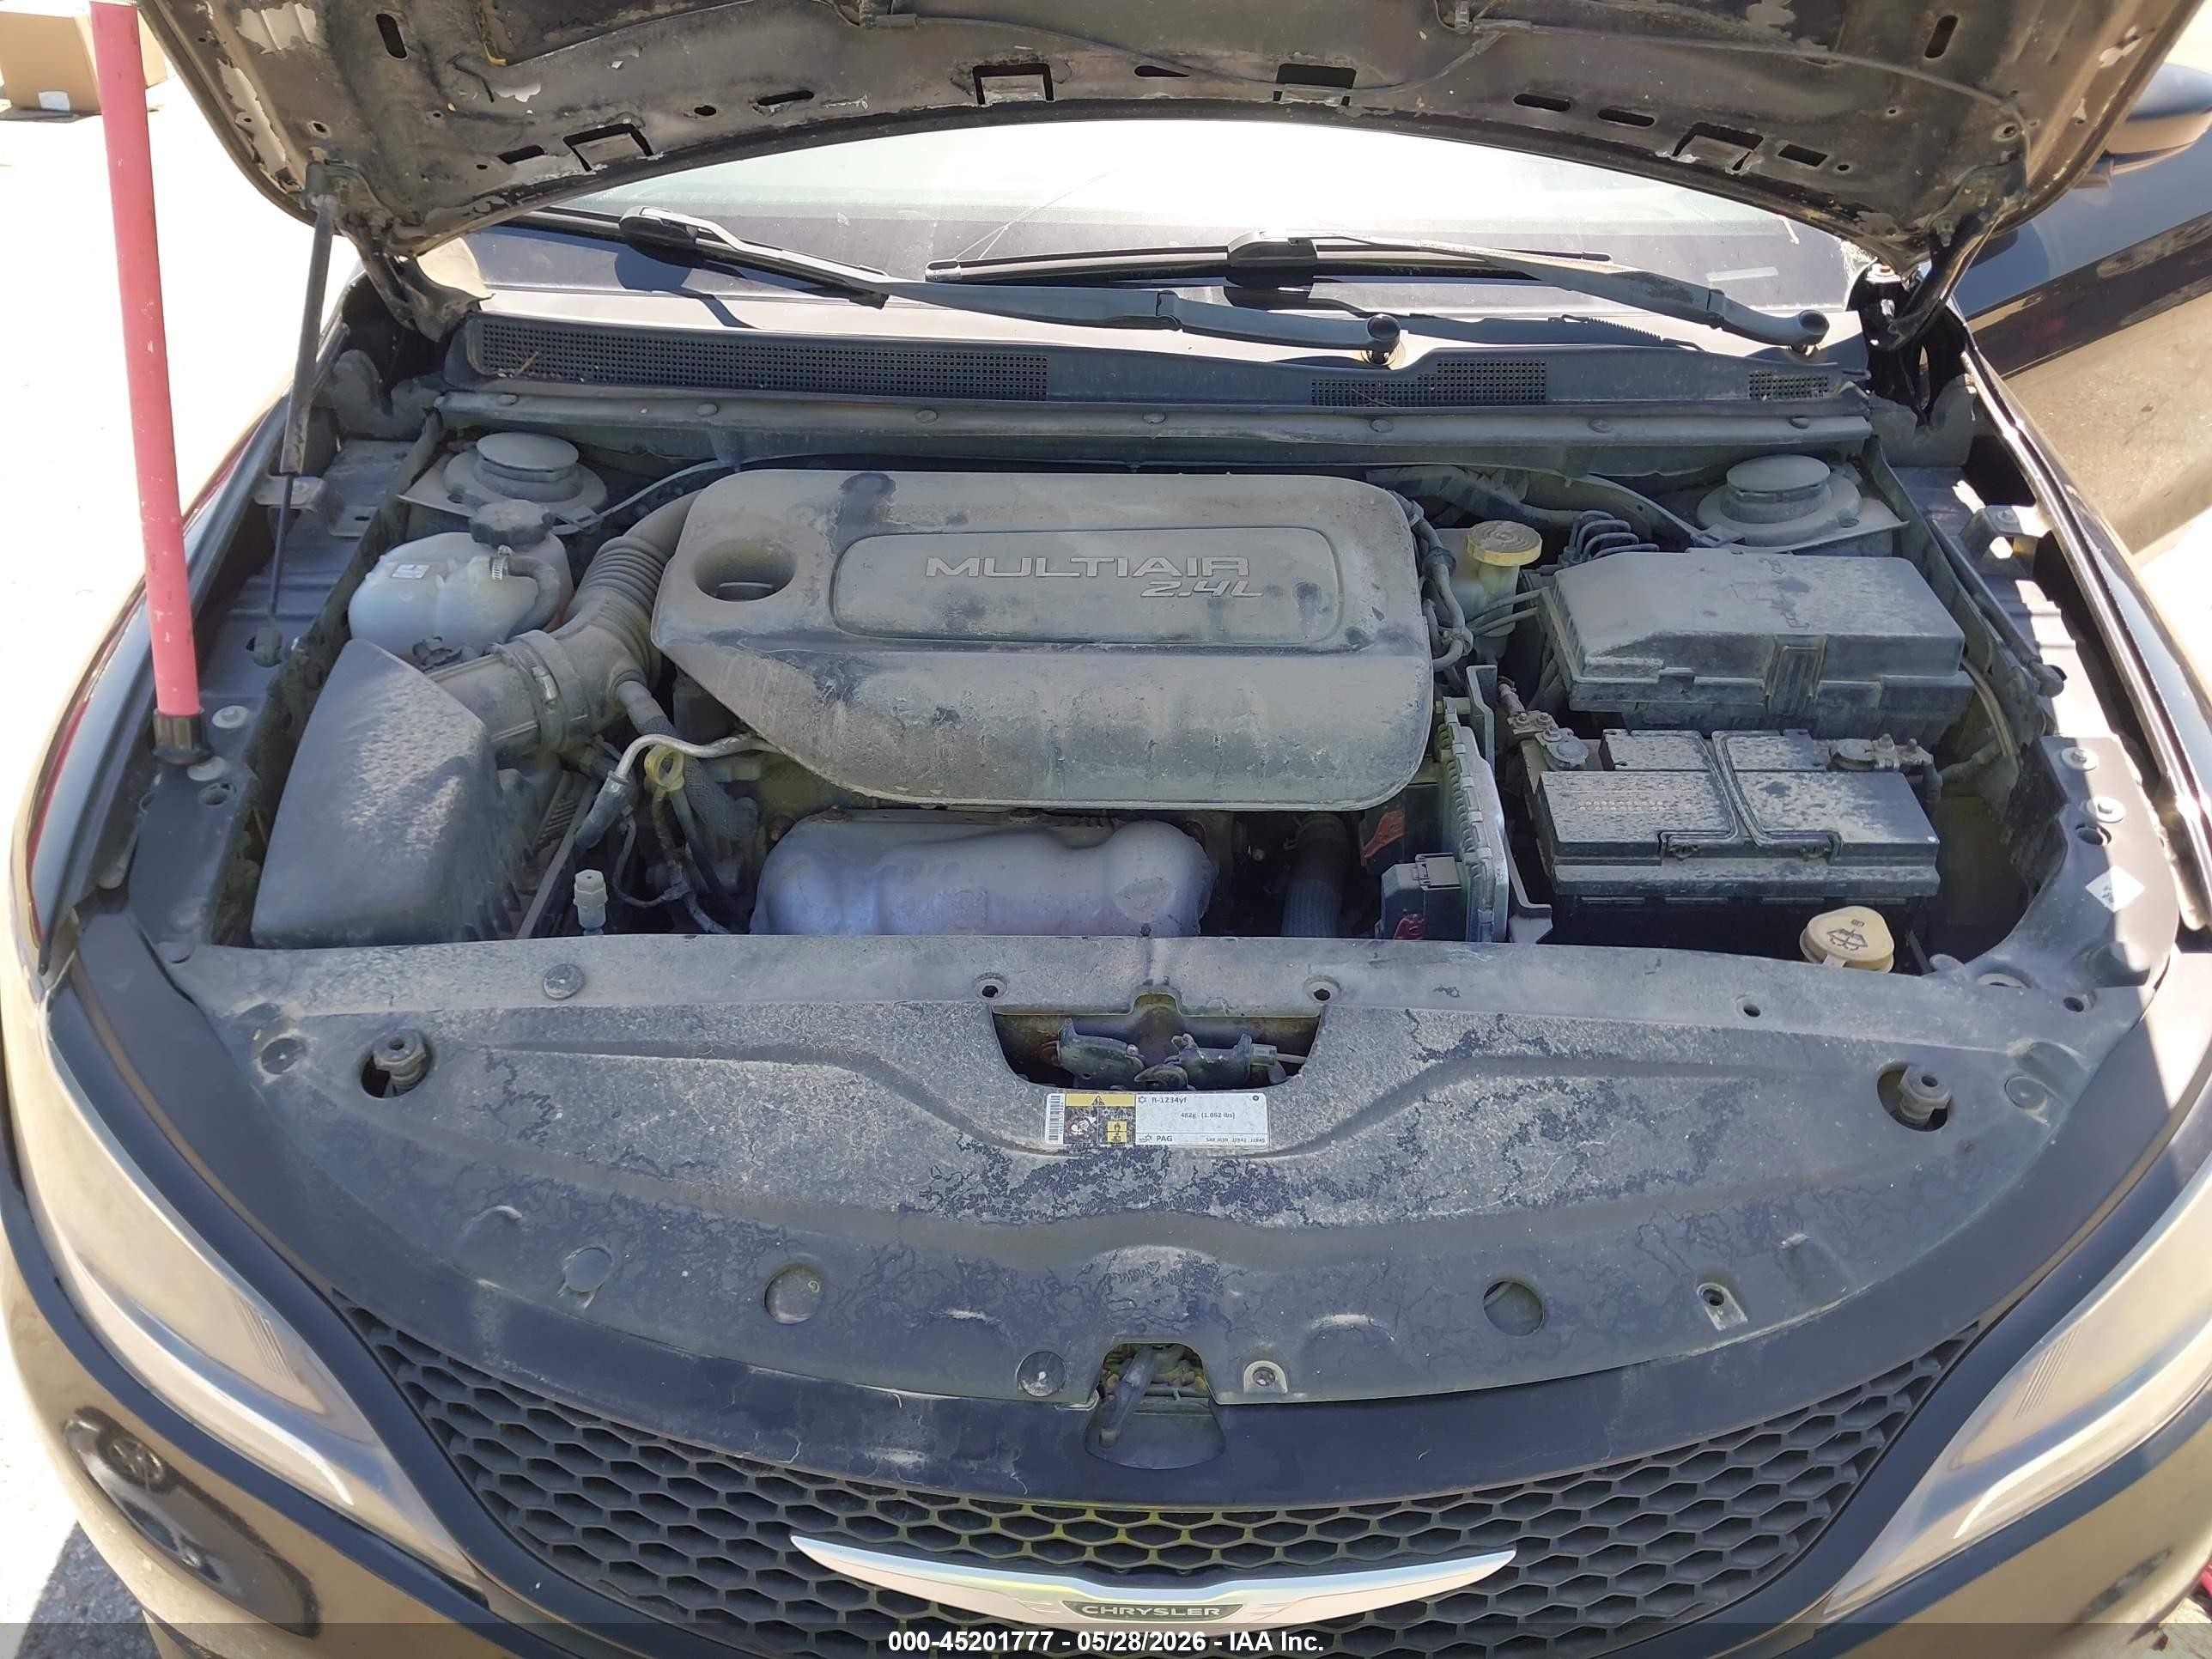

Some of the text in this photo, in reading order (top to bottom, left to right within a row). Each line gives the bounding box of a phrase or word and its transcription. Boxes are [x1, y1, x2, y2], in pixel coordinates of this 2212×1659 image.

[926, 556, 1250, 578] MULTIAIR
[1140, 580, 1263, 598] 2.4L
[1152, 1096, 1187, 1104] R-1234yf
[1081, 1605, 1221, 1616] CHRYSLER
